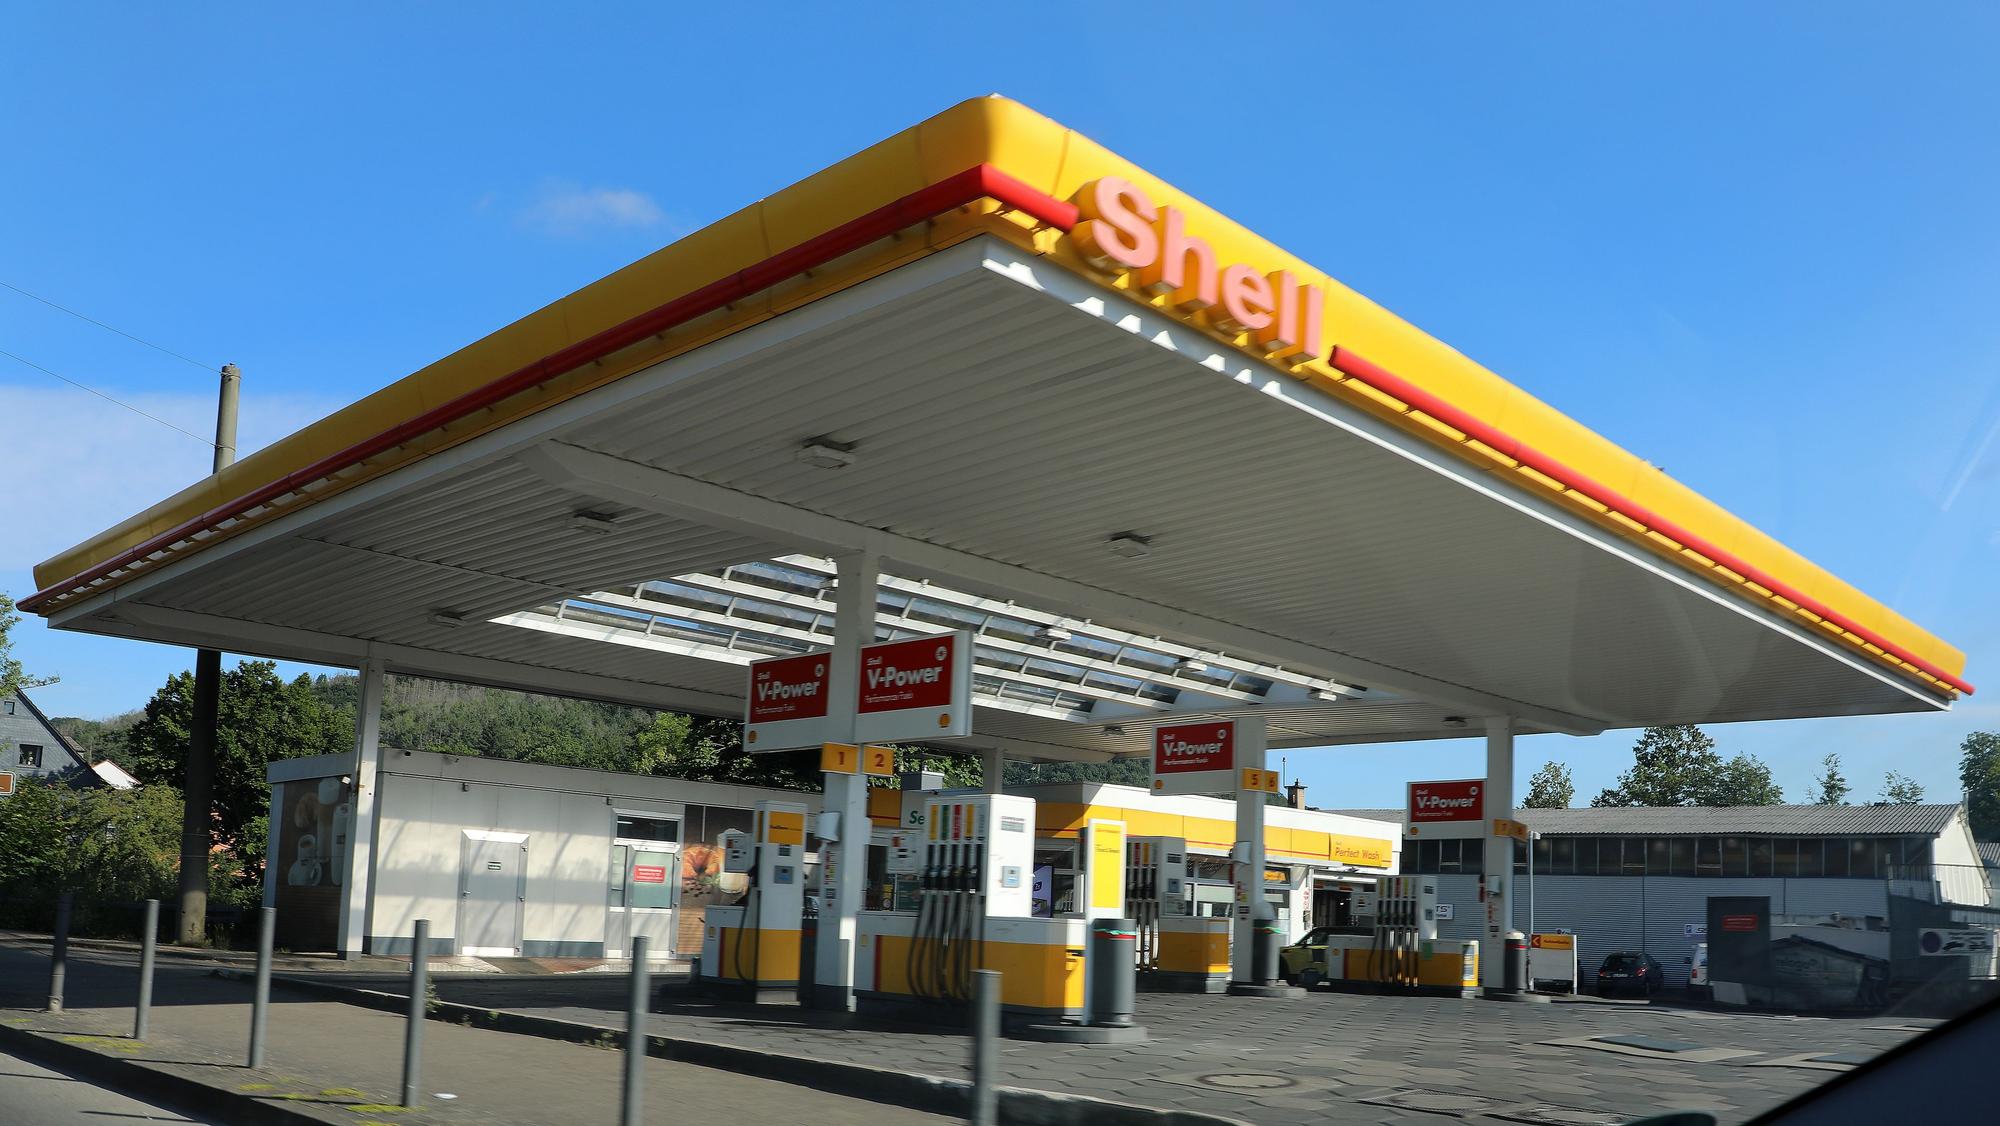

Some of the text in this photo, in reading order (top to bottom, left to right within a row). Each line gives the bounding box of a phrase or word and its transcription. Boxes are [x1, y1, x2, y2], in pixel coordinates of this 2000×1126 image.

[1088, 175, 1323, 359] Shell
[867, 666, 944, 689] V-Power
[757, 681, 820, 701] V-Power
[1163, 741, 1223, 756] V-Power
[838, 752, 845, 766] 1
[874, 753, 885, 767] 2
[1251, 774, 1258, 786] 5
[1415, 795, 1476, 809] V-Power
[909, 810, 925, 825] Se
[1335, 847, 1380, 861] Perfect Wash
